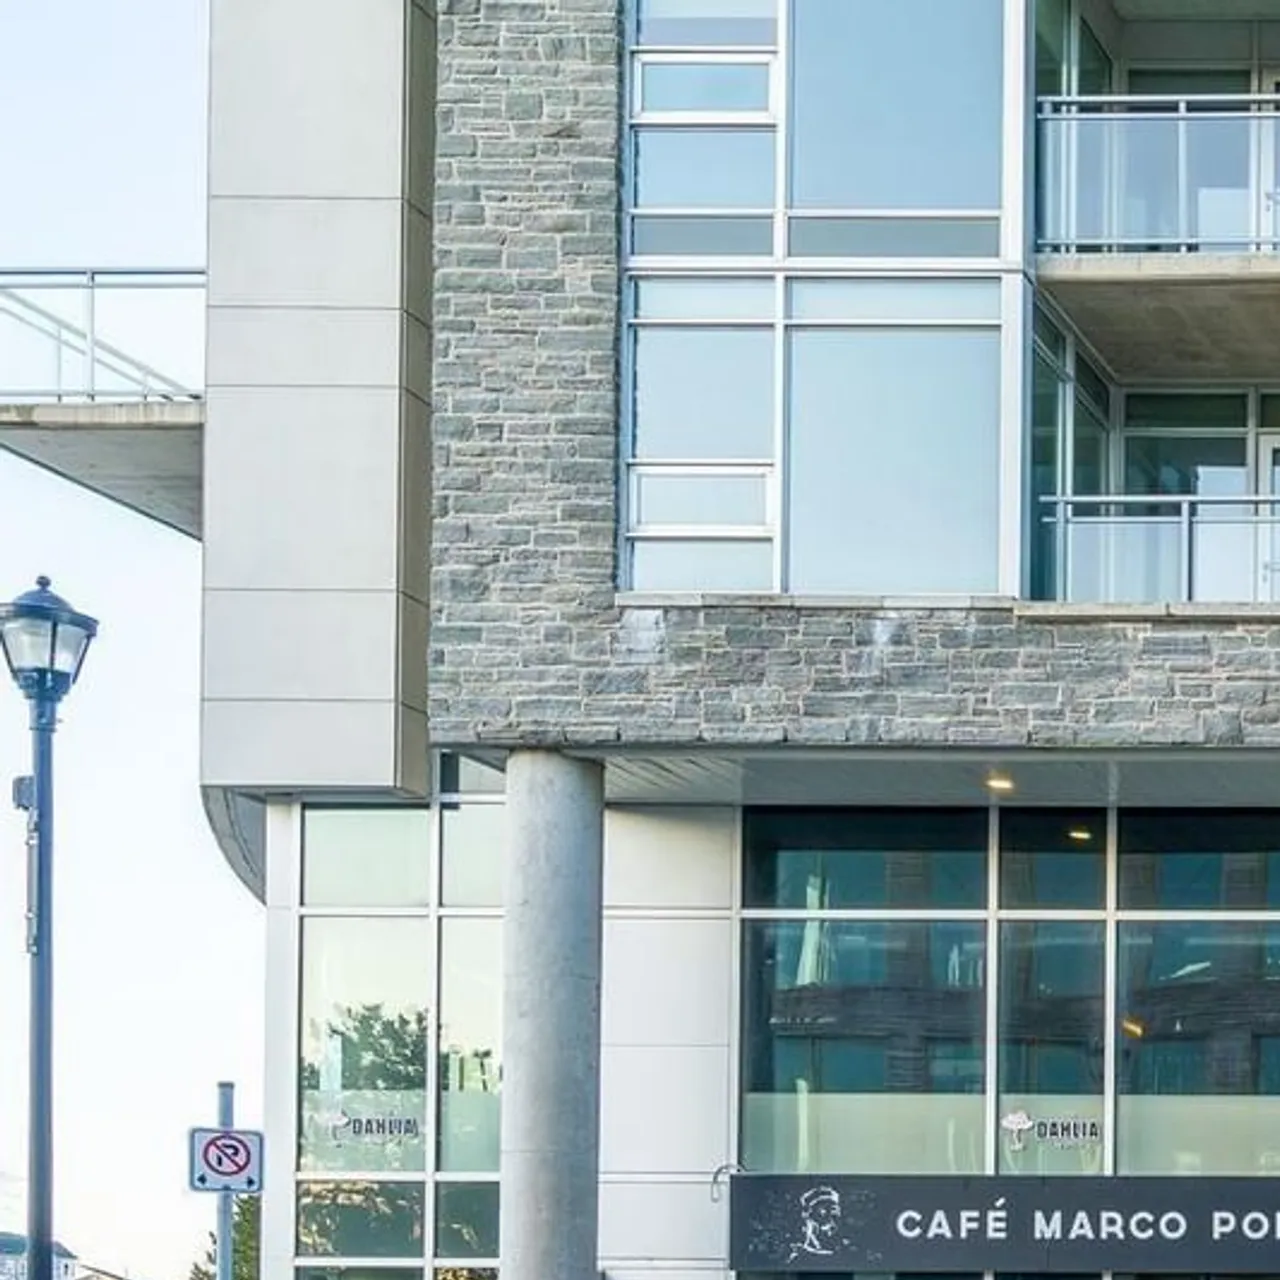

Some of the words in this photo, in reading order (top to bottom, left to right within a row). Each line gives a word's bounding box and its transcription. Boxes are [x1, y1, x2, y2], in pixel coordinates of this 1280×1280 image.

[1036, 1119, 1099, 1139] DAHLIA
[896, 1197, 1008, 1239] CAFÉ
[1034, 1210, 1188, 1240] MARCO
